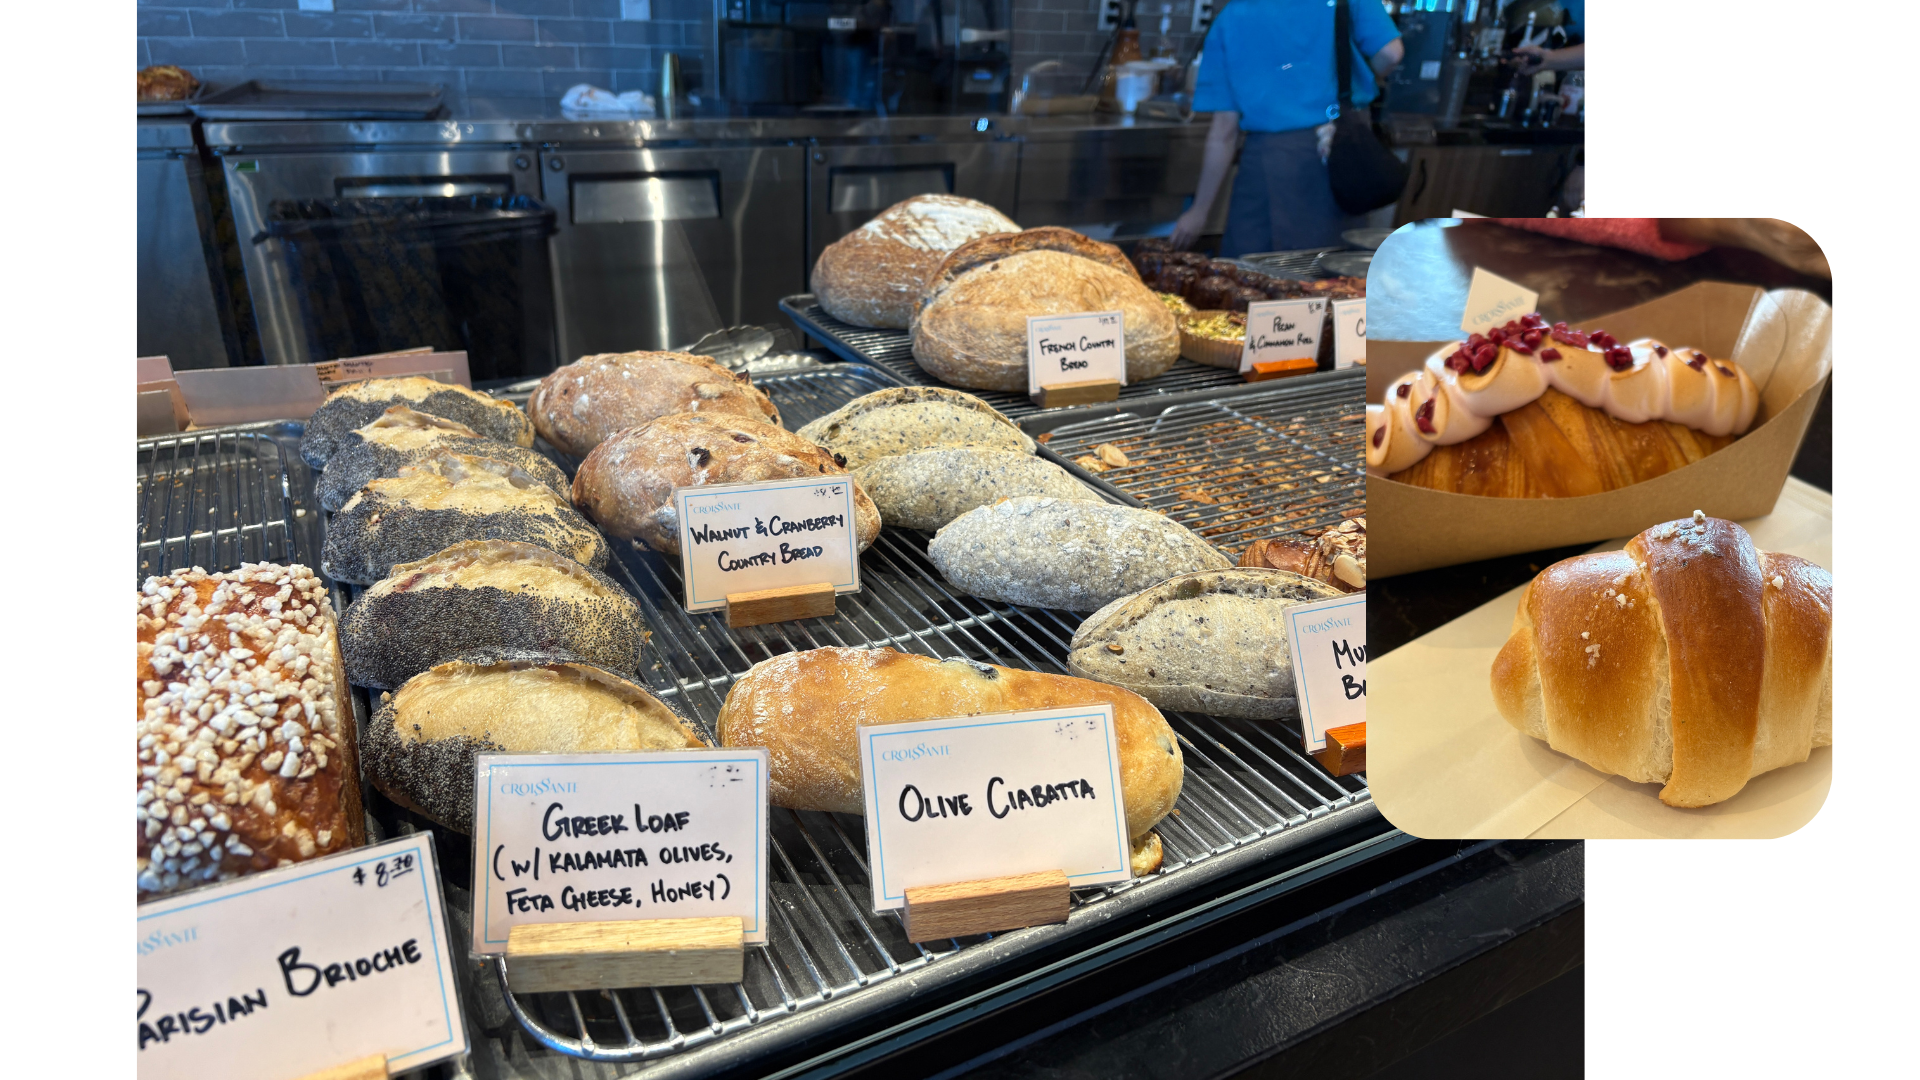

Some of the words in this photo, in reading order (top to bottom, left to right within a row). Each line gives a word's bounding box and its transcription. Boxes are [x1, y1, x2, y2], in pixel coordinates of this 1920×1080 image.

[1039, 338, 1076, 355] FRENCH
[1080, 336, 1115, 351] COUNTRY
[1060, 357, 1088, 372] BREAD
[690, 524, 750, 545] WALNUT
[755, 517, 768, 537] &
[769, 514, 844, 536] CRANBERRY
[718, 550, 776, 572] COUNTRY
[779, 542, 823, 564] BREAD
[899, 784, 973, 822] OLIVE
[987, 776, 1095, 819] CIABATTA
[542, 802, 629, 841] GREEK
[634, 803, 690, 833] LOAF
[549, 847, 649, 874] KALAMATA
[659, 842, 733, 864] OLIVES,
[506, 887, 554, 915] FETA
[561, 885, 642, 911] CHEESE,
[651, 873, 731, 903] HONEY)
[277, 938, 423, 997] BRIOCHE
